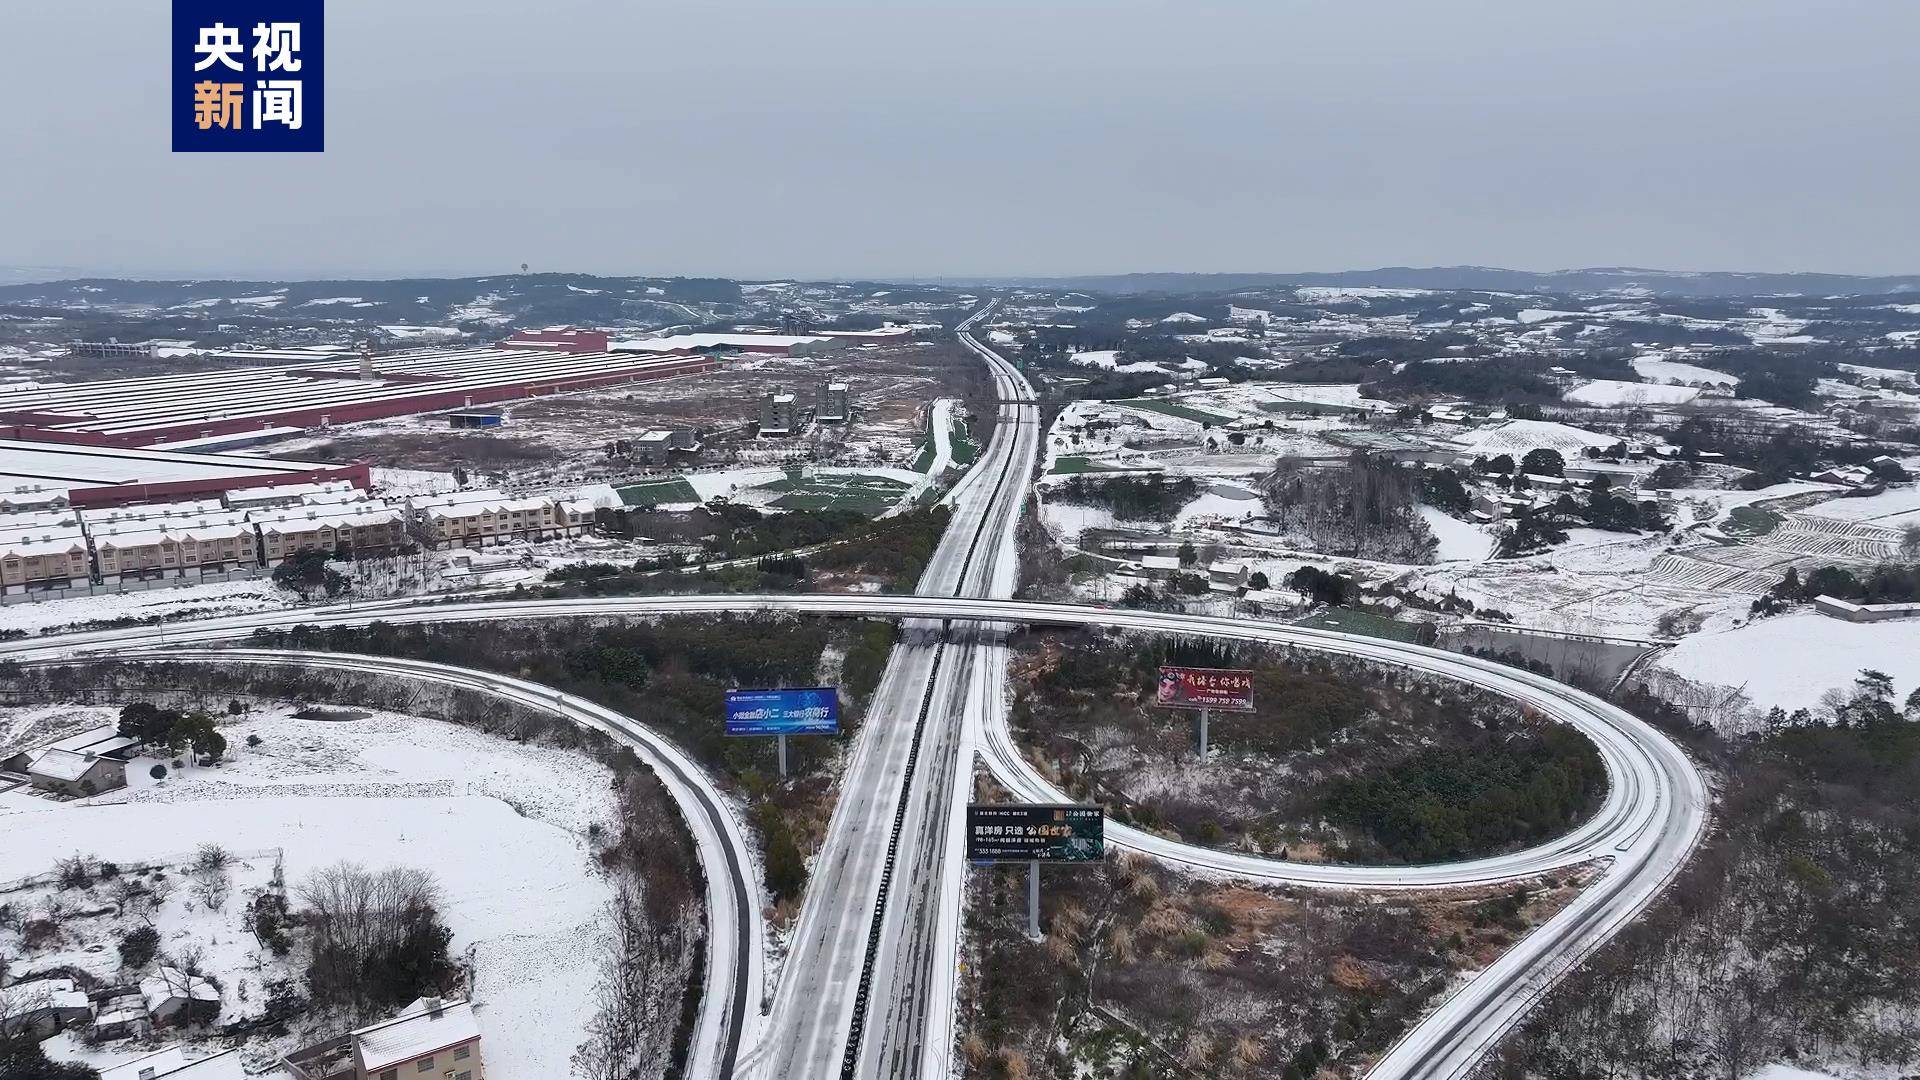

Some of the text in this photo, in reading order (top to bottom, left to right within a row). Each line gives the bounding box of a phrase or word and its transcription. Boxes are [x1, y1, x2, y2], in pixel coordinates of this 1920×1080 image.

[975, 825, 1003, 836] 真洋房
[1005, 825, 1023, 836] 只选
